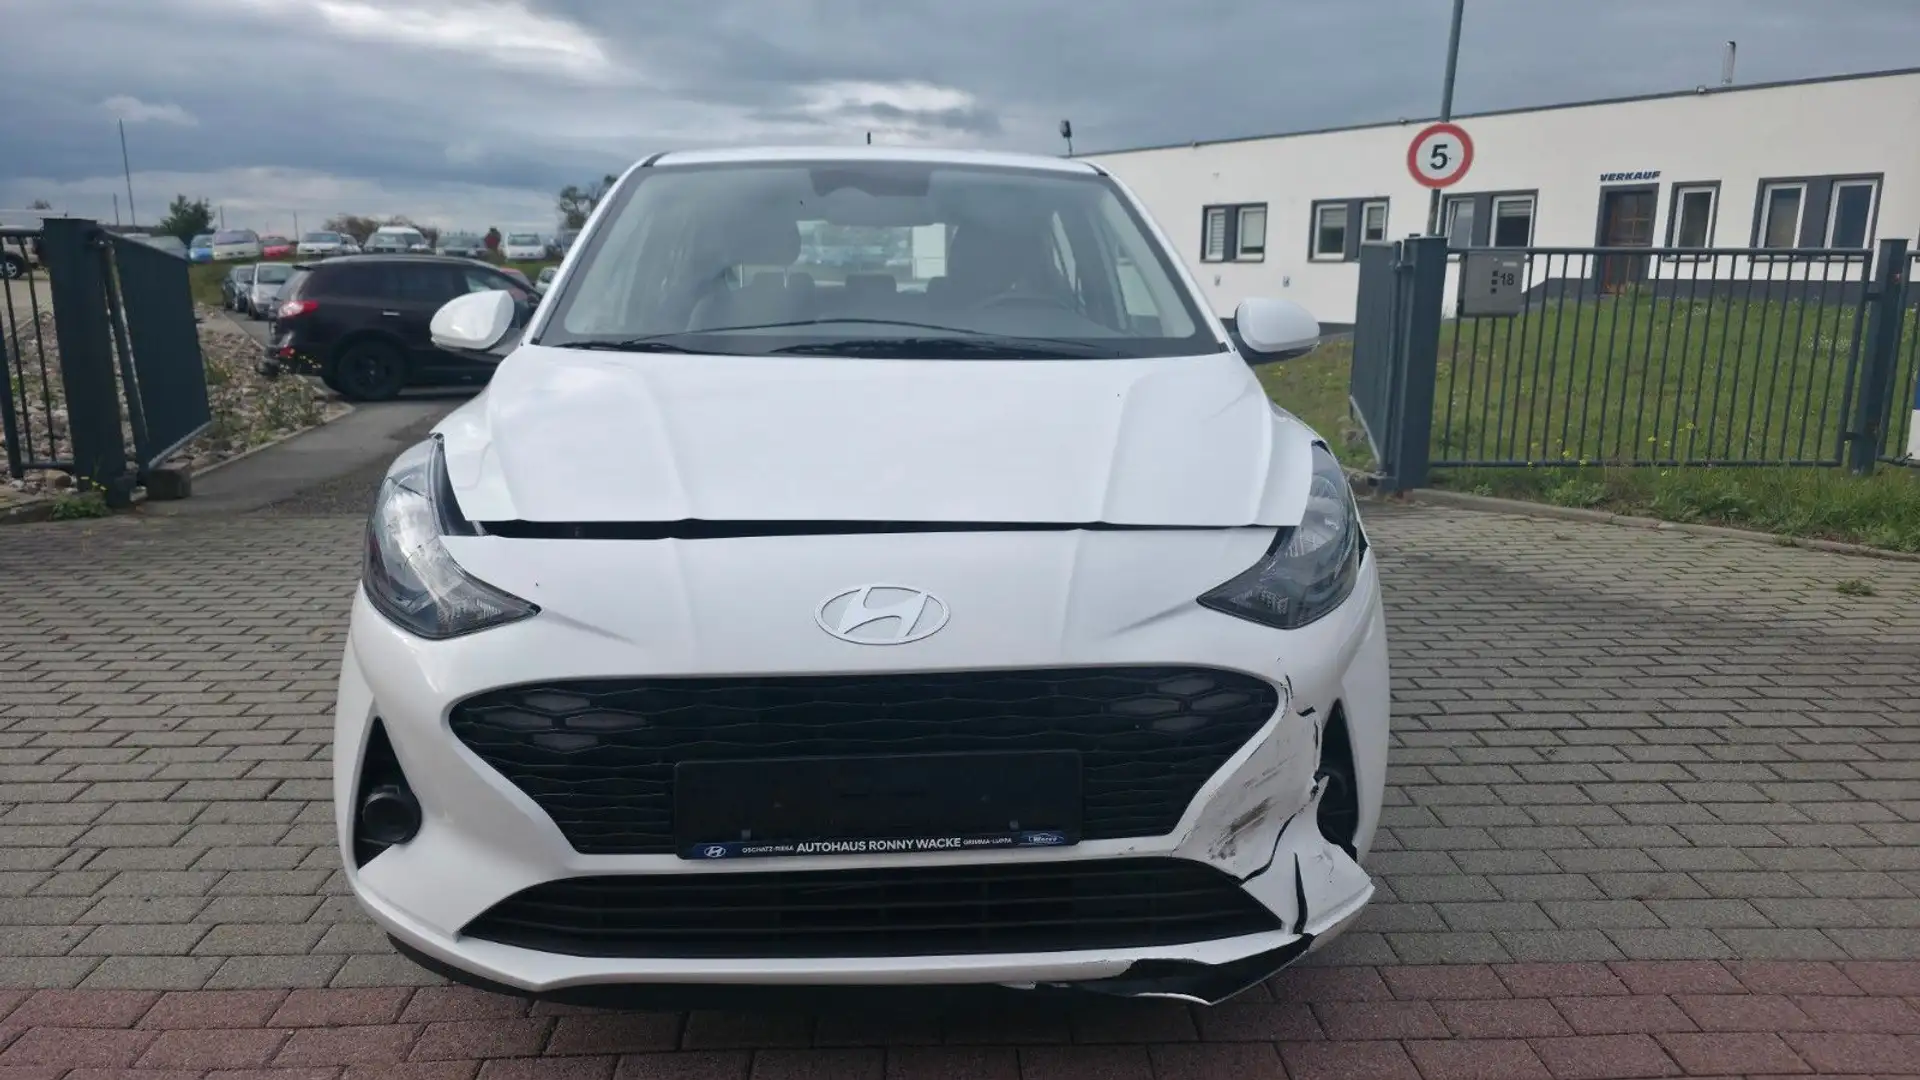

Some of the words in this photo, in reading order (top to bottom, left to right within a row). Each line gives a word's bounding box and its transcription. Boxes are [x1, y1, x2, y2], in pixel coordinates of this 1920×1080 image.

[1430, 144, 1448, 170] 5
[1600, 170, 1661, 181] VERKAUF
[1500, 272, 1515, 286] 18
[796, 841, 866, 853] AUTOHAUS
[868, 839, 914, 851] RONNY
[915, 837, 961, 849] WACKE
